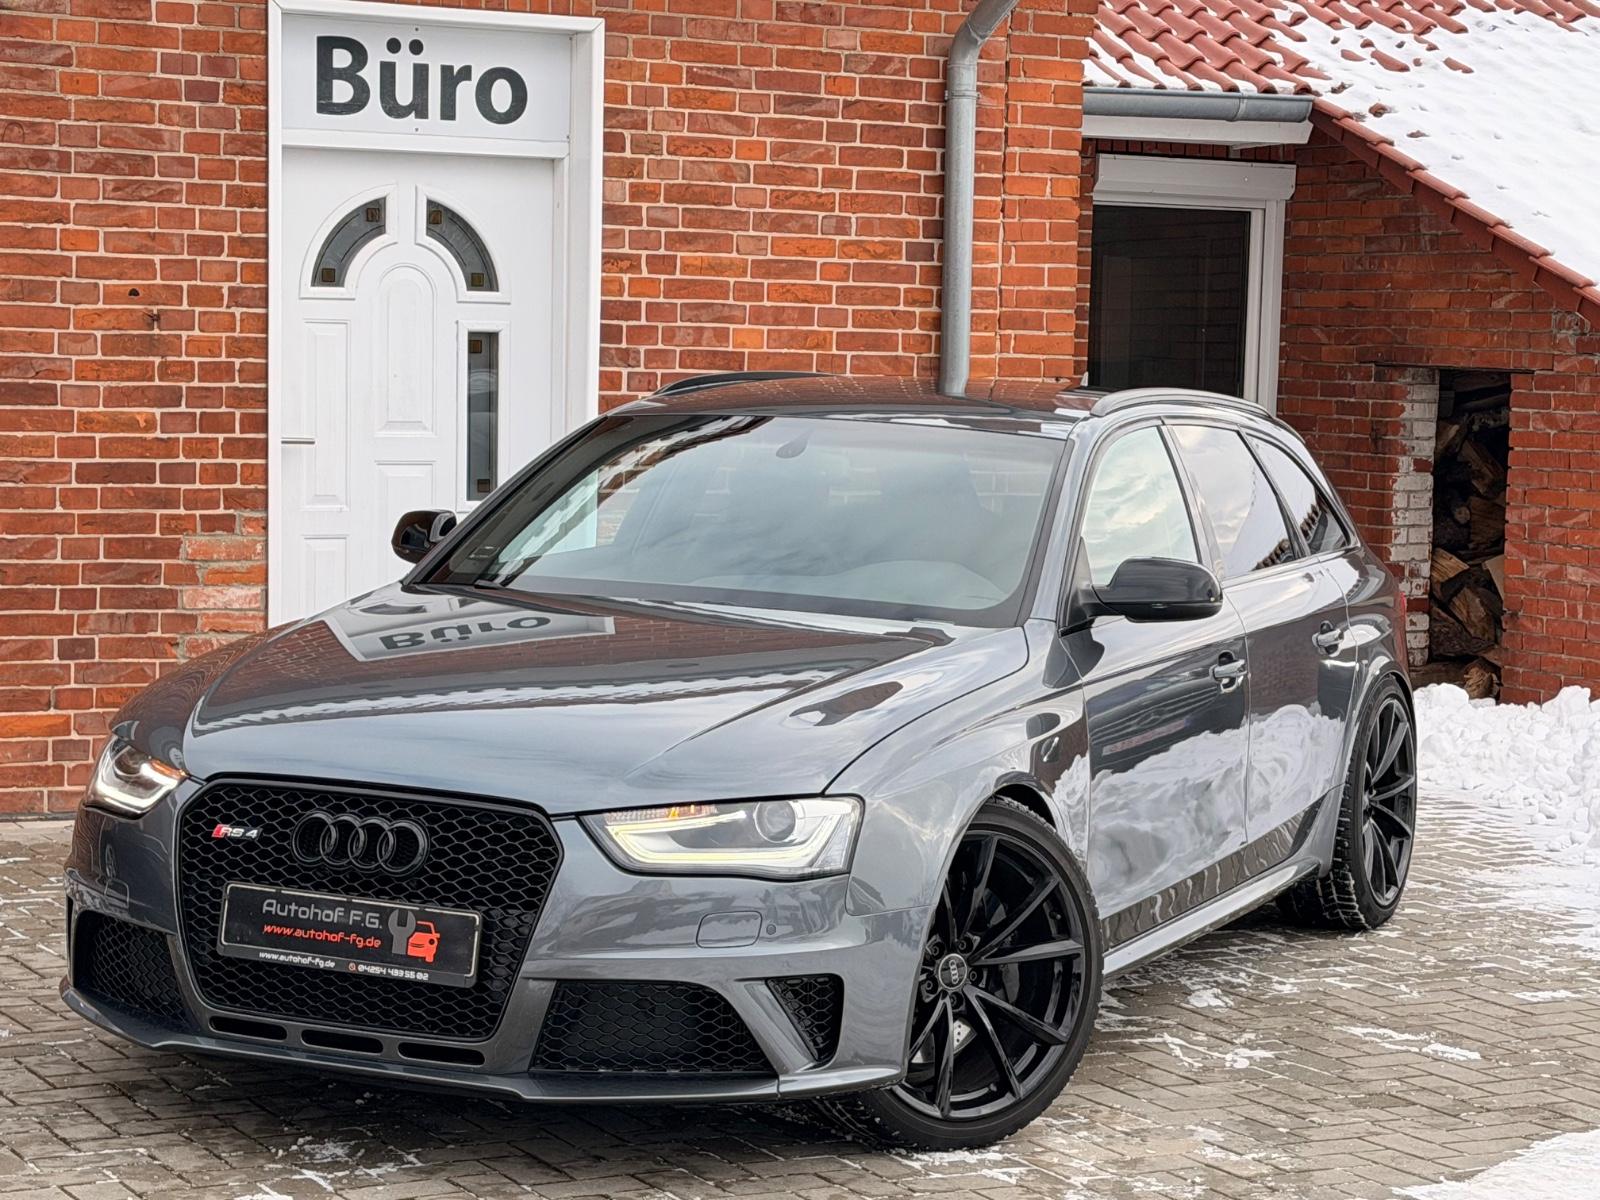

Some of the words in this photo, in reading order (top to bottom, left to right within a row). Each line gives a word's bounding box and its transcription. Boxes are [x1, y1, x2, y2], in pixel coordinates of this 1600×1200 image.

[317, 35, 528, 125] Büro
[262, 899, 344, 922] Autohof
[349, 910, 383, 929] F.G.
[262, 924, 382, 949] www.autohof-fg.de
[259, 951, 336, 968] www.autohof-fg.de
